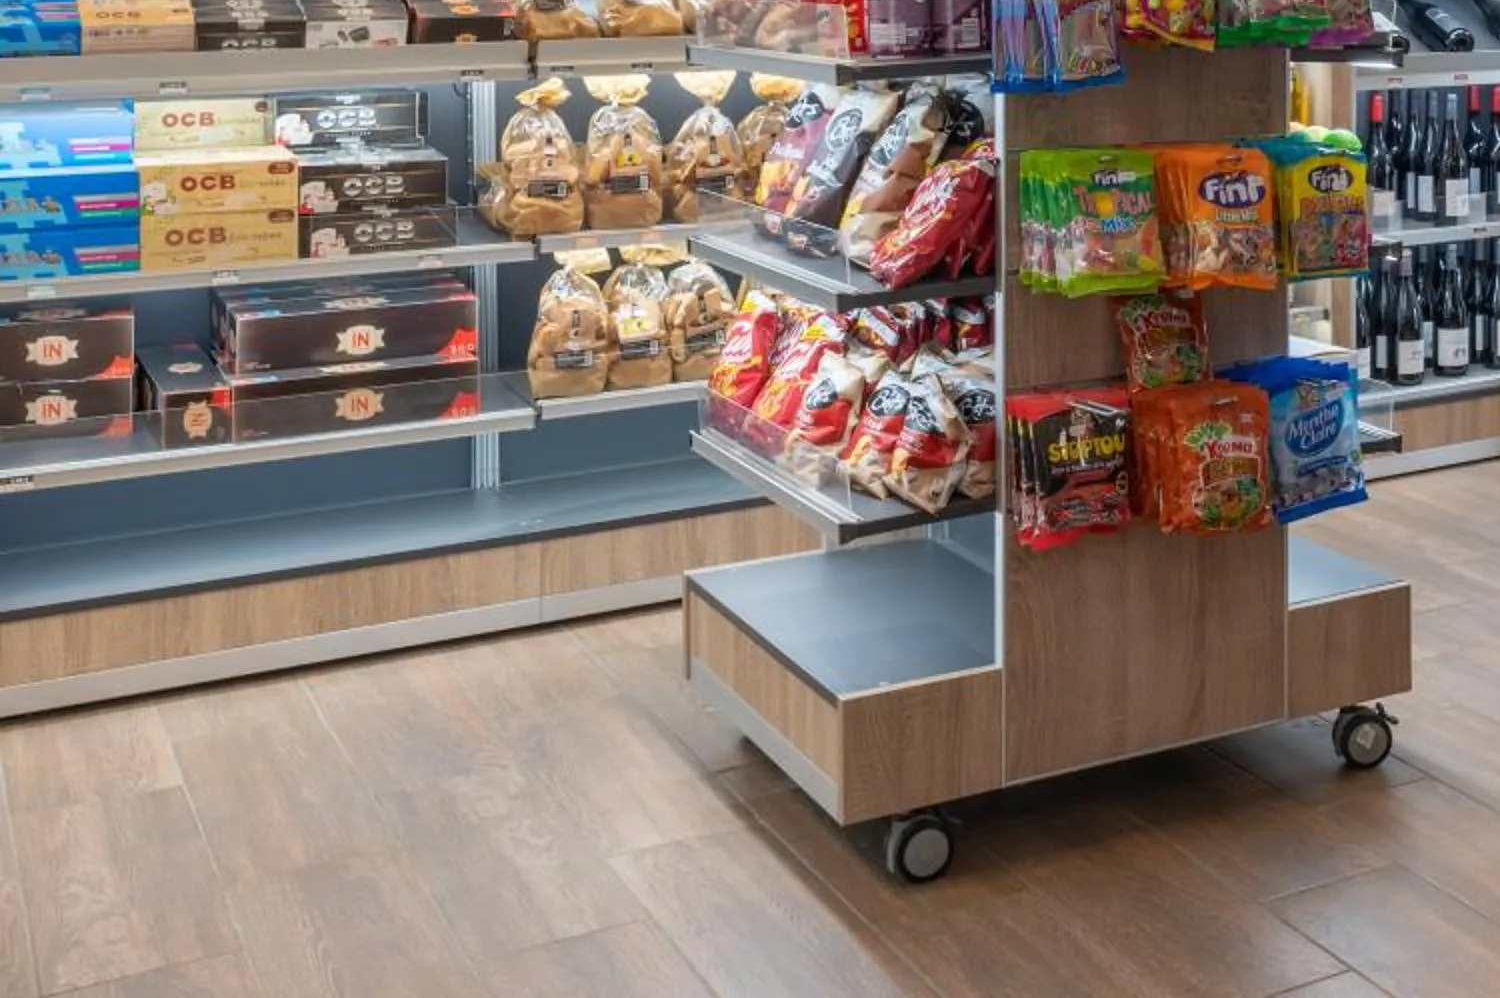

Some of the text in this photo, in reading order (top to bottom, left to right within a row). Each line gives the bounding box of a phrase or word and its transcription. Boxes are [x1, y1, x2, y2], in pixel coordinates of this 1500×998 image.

[162, 112, 215, 128] OCB
[316, 108, 377, 129] OCB
[180, 175, 236, 192] OCB
[343, 175, 405, 197] OCB
[165, 227, 227, 246] OCB
[354, 220, 415, 242] OCB
[352, 332, 370, 348] IN
[351, 395, 369, 412] IN
